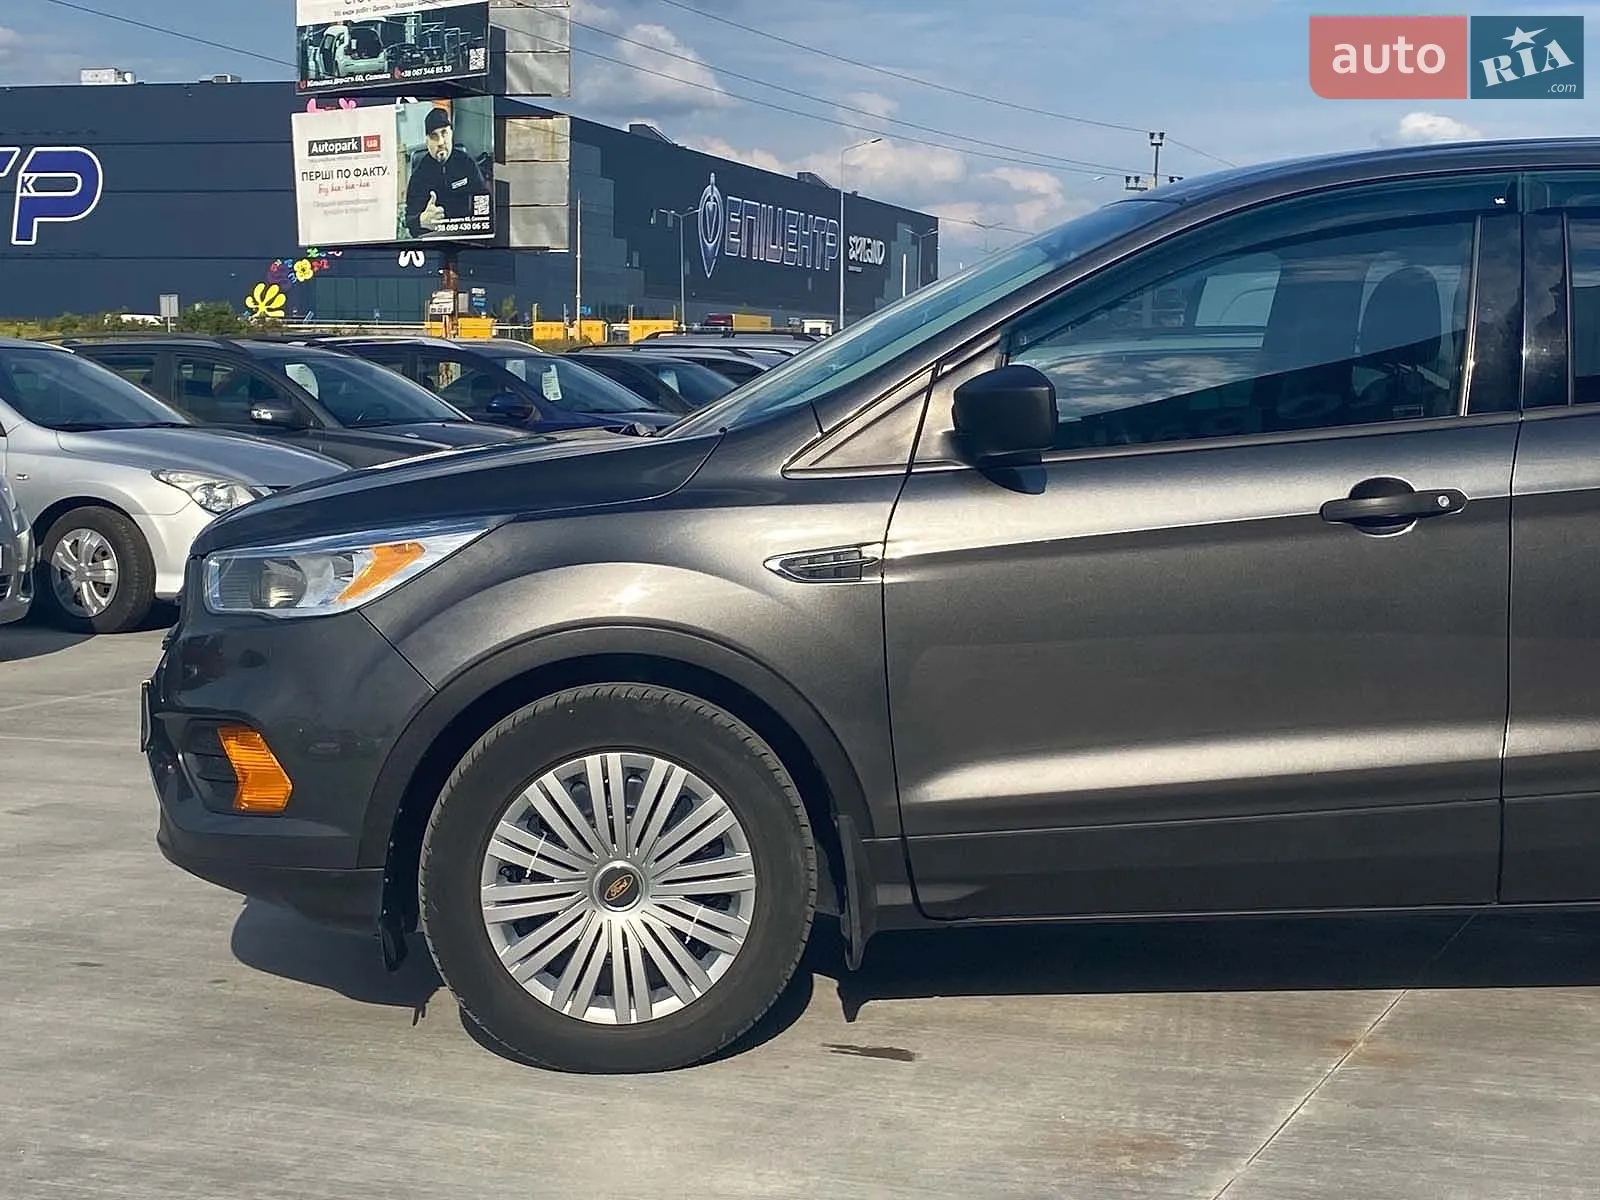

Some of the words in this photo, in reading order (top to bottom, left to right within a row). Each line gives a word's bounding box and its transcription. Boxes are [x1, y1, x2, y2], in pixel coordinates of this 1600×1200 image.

[311, 138, 359, 154] Autopark
[301, 169, 334, 182] ПЕРШІ
[336, 168, 352, 179] ПО
[353, 166, 391, 178] ФАКТУ.
[724, 195, 840, 272] ЕПІЦЕНТР
